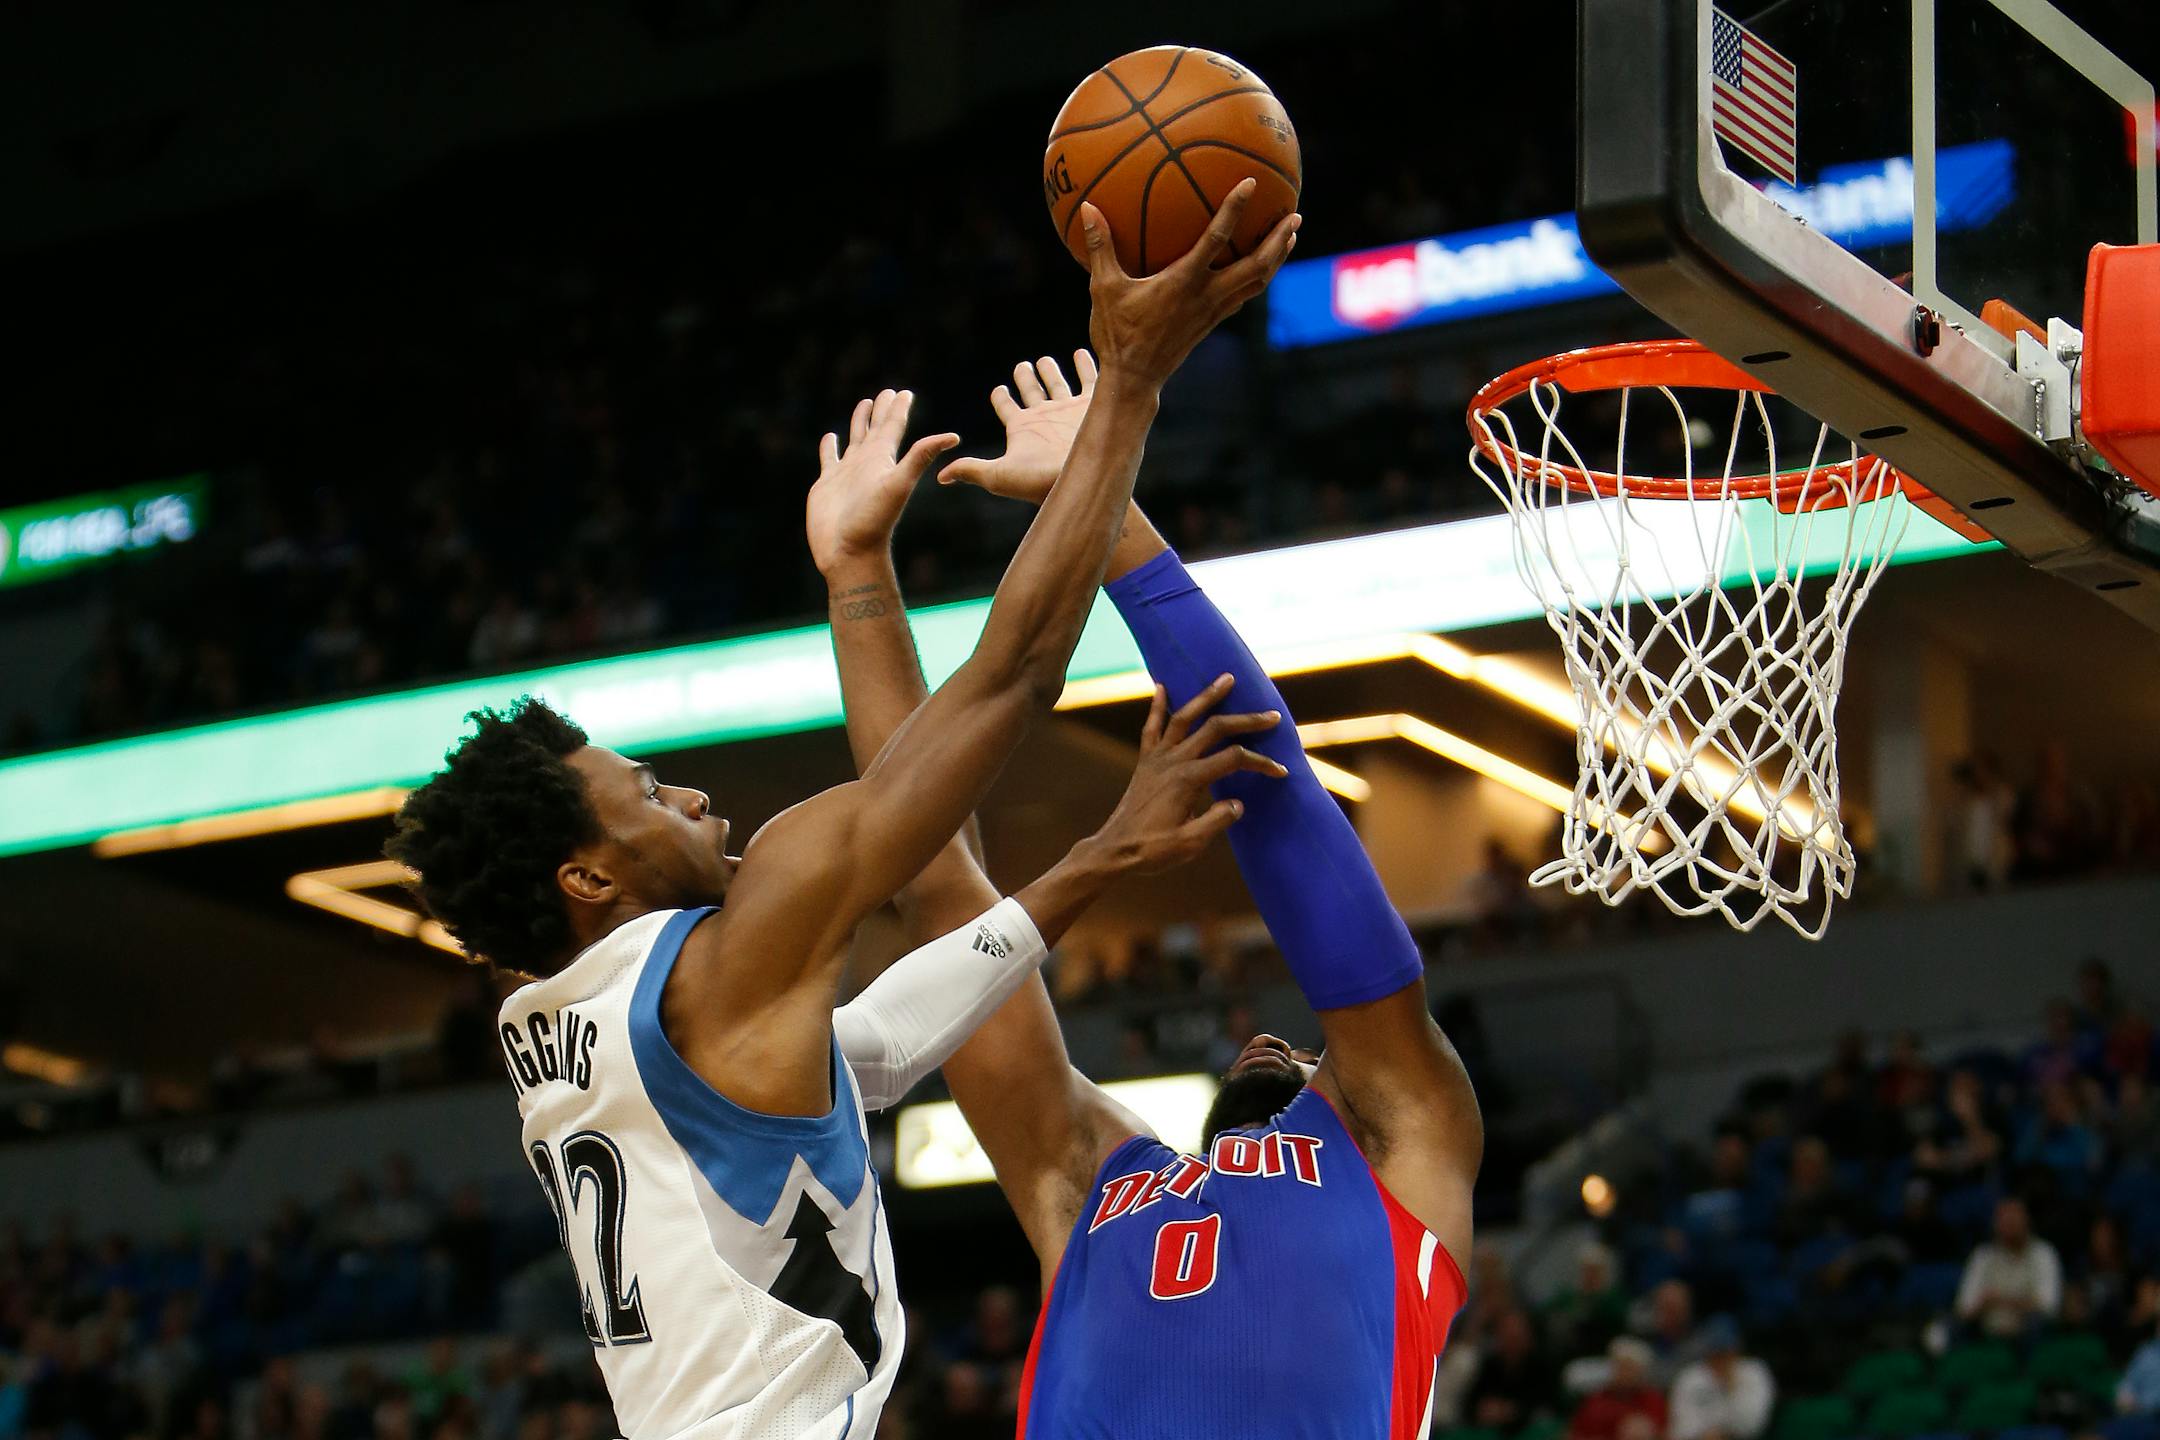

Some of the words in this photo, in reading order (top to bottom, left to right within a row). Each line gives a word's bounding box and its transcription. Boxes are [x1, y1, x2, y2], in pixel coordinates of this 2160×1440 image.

[978, 924, 1006, 959] adidas
[1088, 1130, 1323, 1235] DETOIT
[1149, 1212, 1222, 1301] 0
